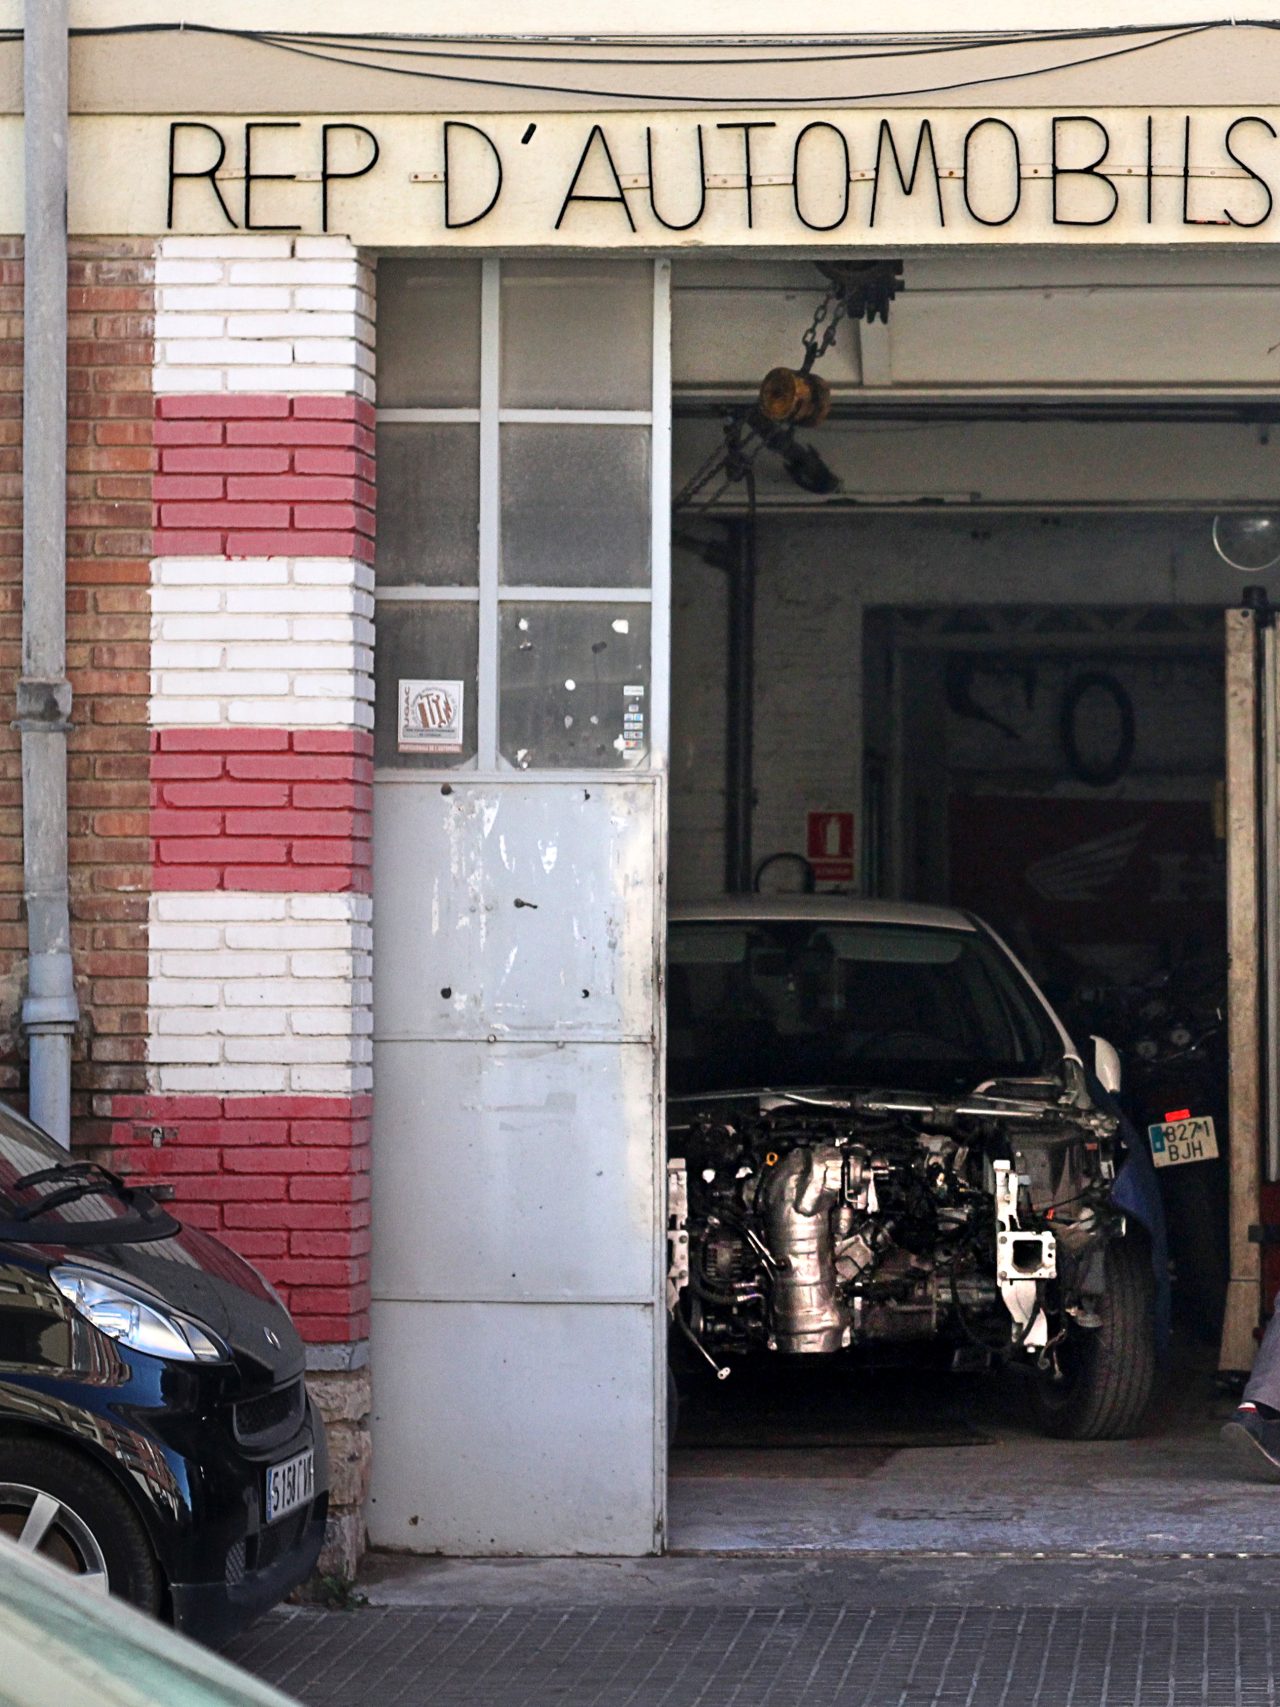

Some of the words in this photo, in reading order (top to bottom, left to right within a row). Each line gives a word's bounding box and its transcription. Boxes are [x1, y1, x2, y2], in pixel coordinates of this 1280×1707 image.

[167, 122, 380, 232] REP
[1165, 1121, 1210, 1142] 8271
[1169, 1141, 1203, 1161] BJH
